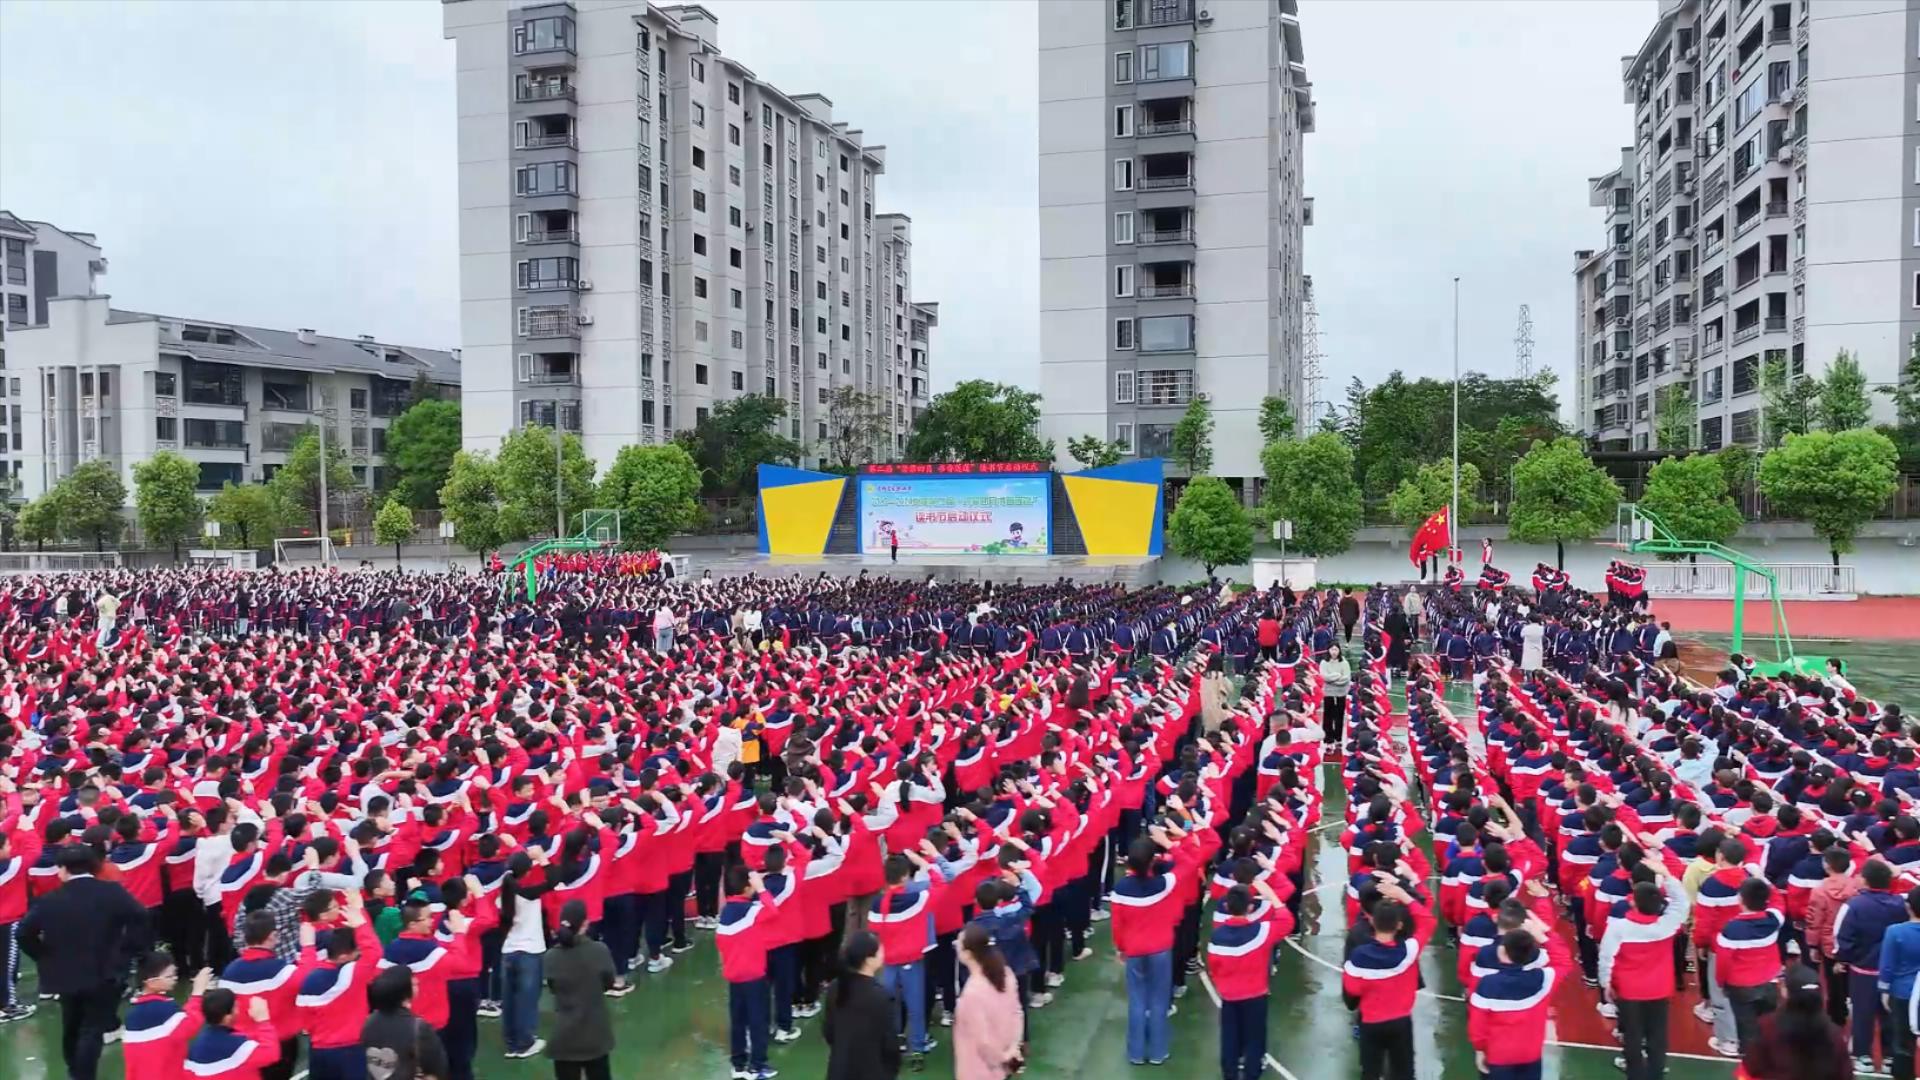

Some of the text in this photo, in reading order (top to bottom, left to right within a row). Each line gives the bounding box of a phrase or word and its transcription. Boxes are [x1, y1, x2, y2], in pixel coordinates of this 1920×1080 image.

[916, 511, 992, 523] 读书节启动仪式
